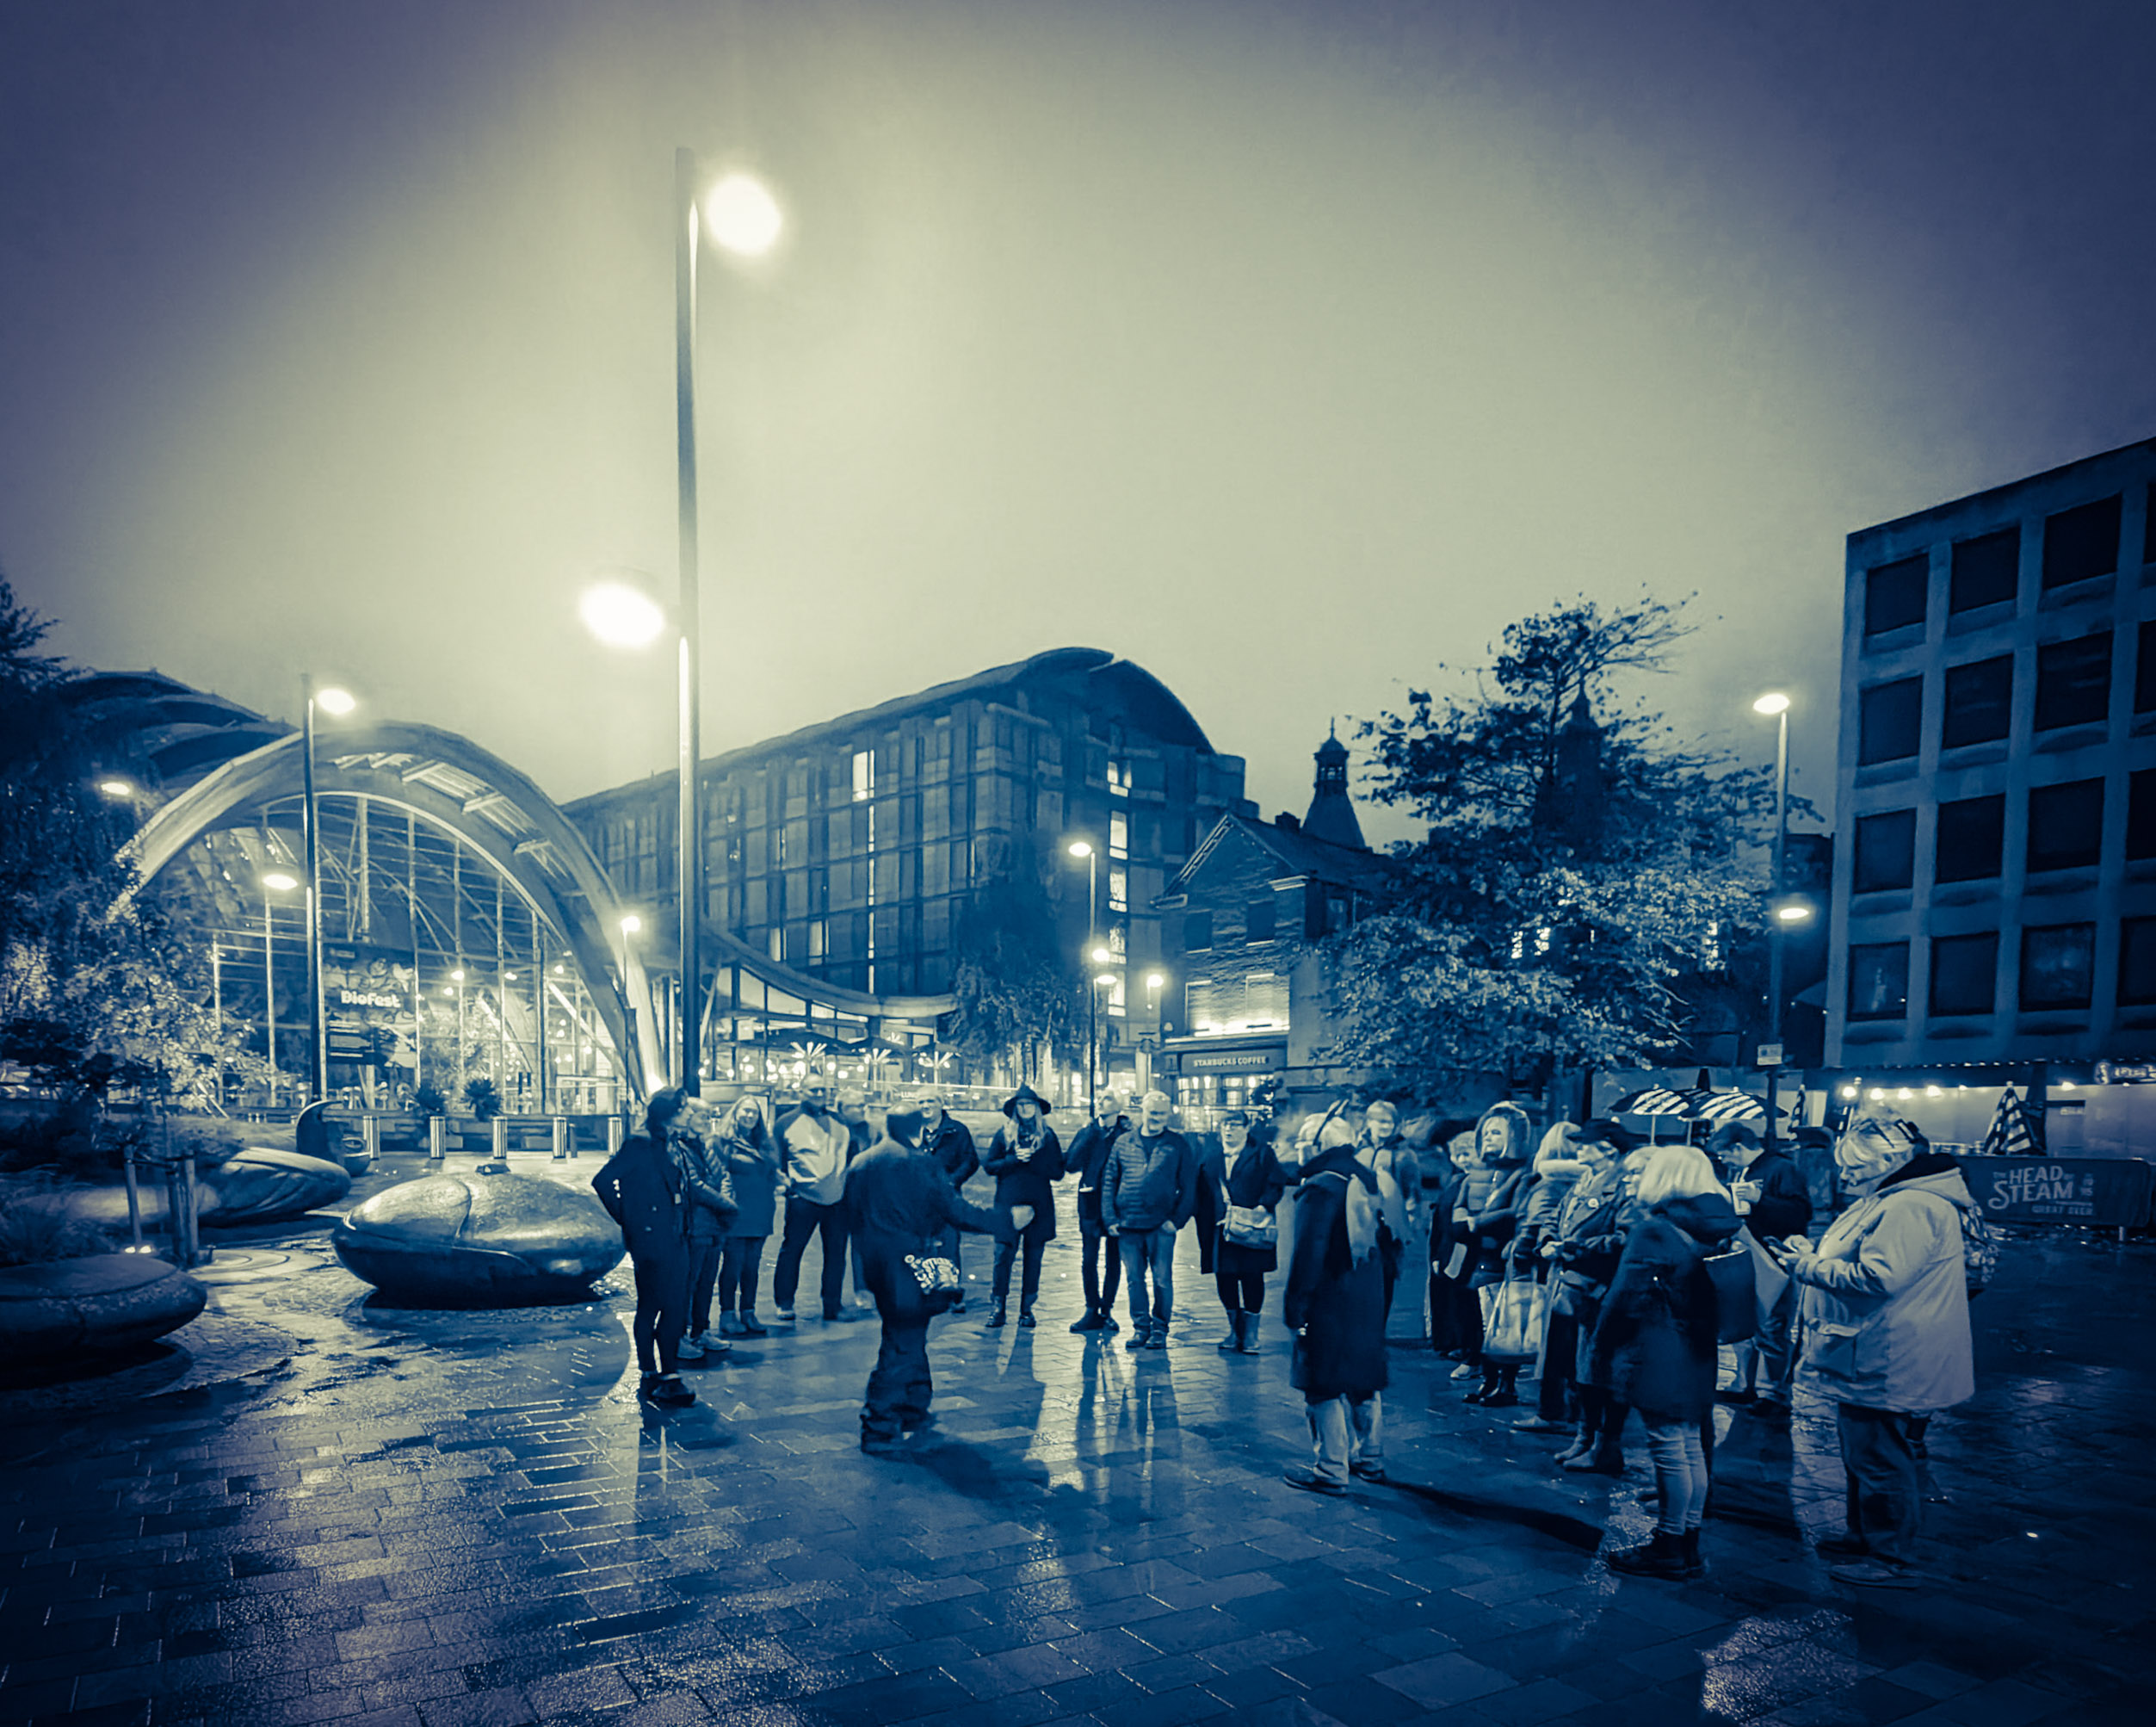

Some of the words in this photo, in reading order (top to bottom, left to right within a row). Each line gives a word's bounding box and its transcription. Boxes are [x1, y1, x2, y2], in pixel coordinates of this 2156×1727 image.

[1194, 1056, 1237, 1067] STARBUCKS
[1238, 1055, 1266, 1064] COFFEE
[2010, 1165, 2064, 1185] HEAD
[1988, 1180, 2073, 1210] STEAM
